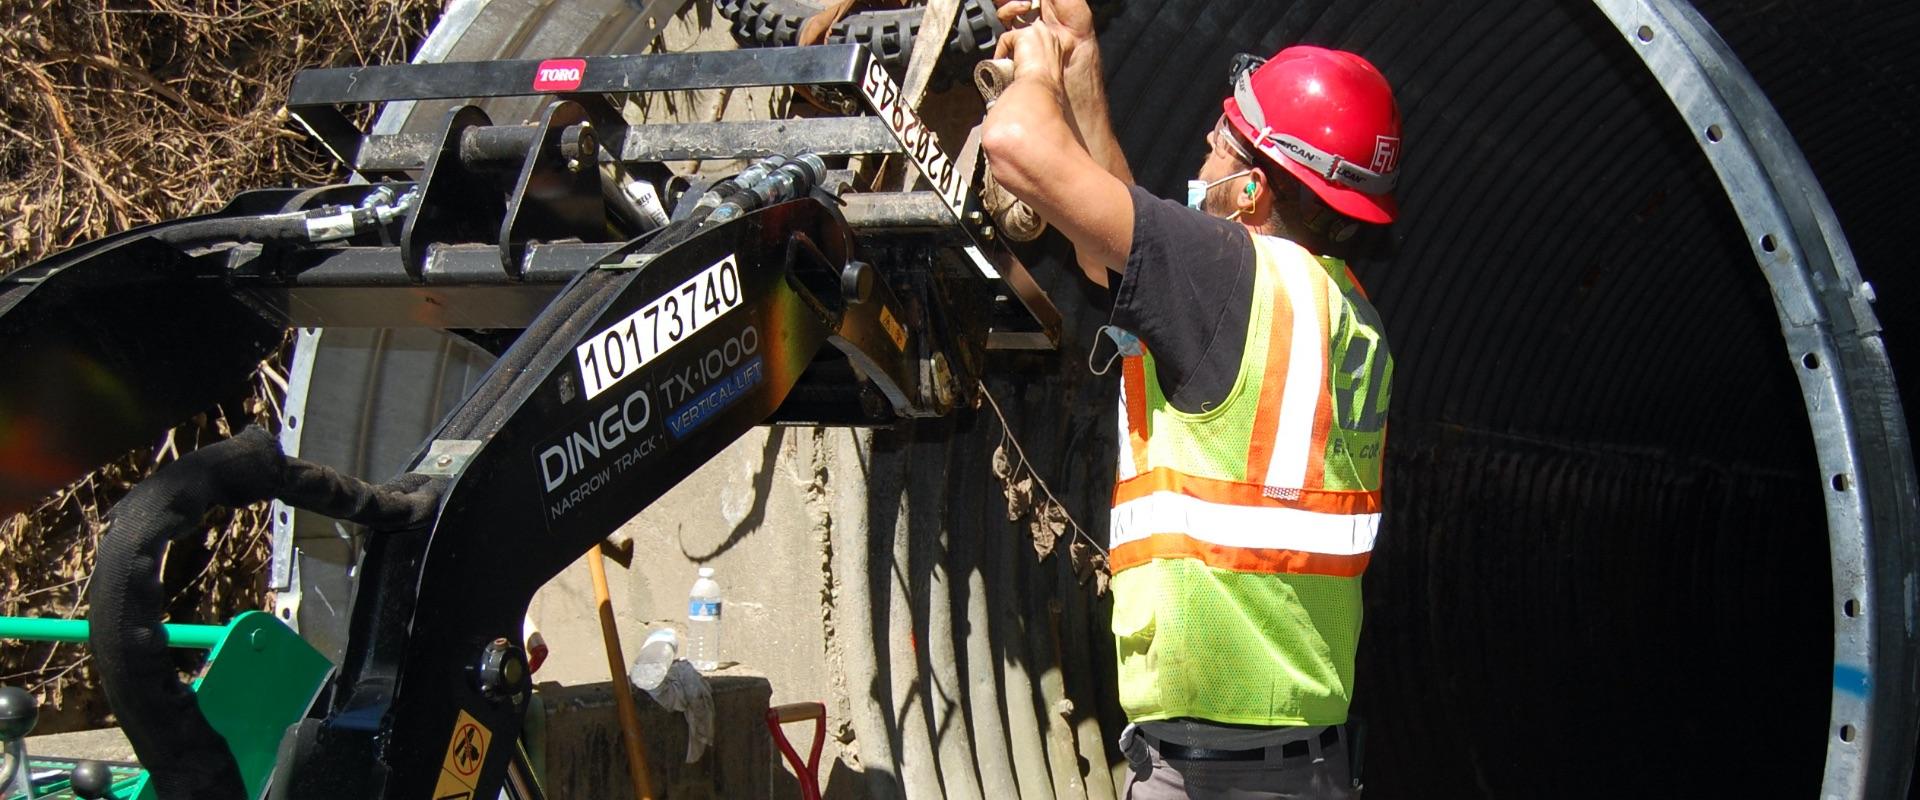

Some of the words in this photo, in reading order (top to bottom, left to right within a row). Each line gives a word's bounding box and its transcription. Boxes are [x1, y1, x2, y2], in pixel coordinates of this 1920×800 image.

[540, 68, 580, 82] TORO
[866, 59, 962, 208] 10202945
[584, 260, 738, 390] 10173740
[540, 390, 650, 493] DINGO
[671, 385, 736, 433] VERTICAL
[736, 361, 763, 391] LIFT
[551, 466, 610, 520] NARROW
[614, 441, 656, 474] TRACK
